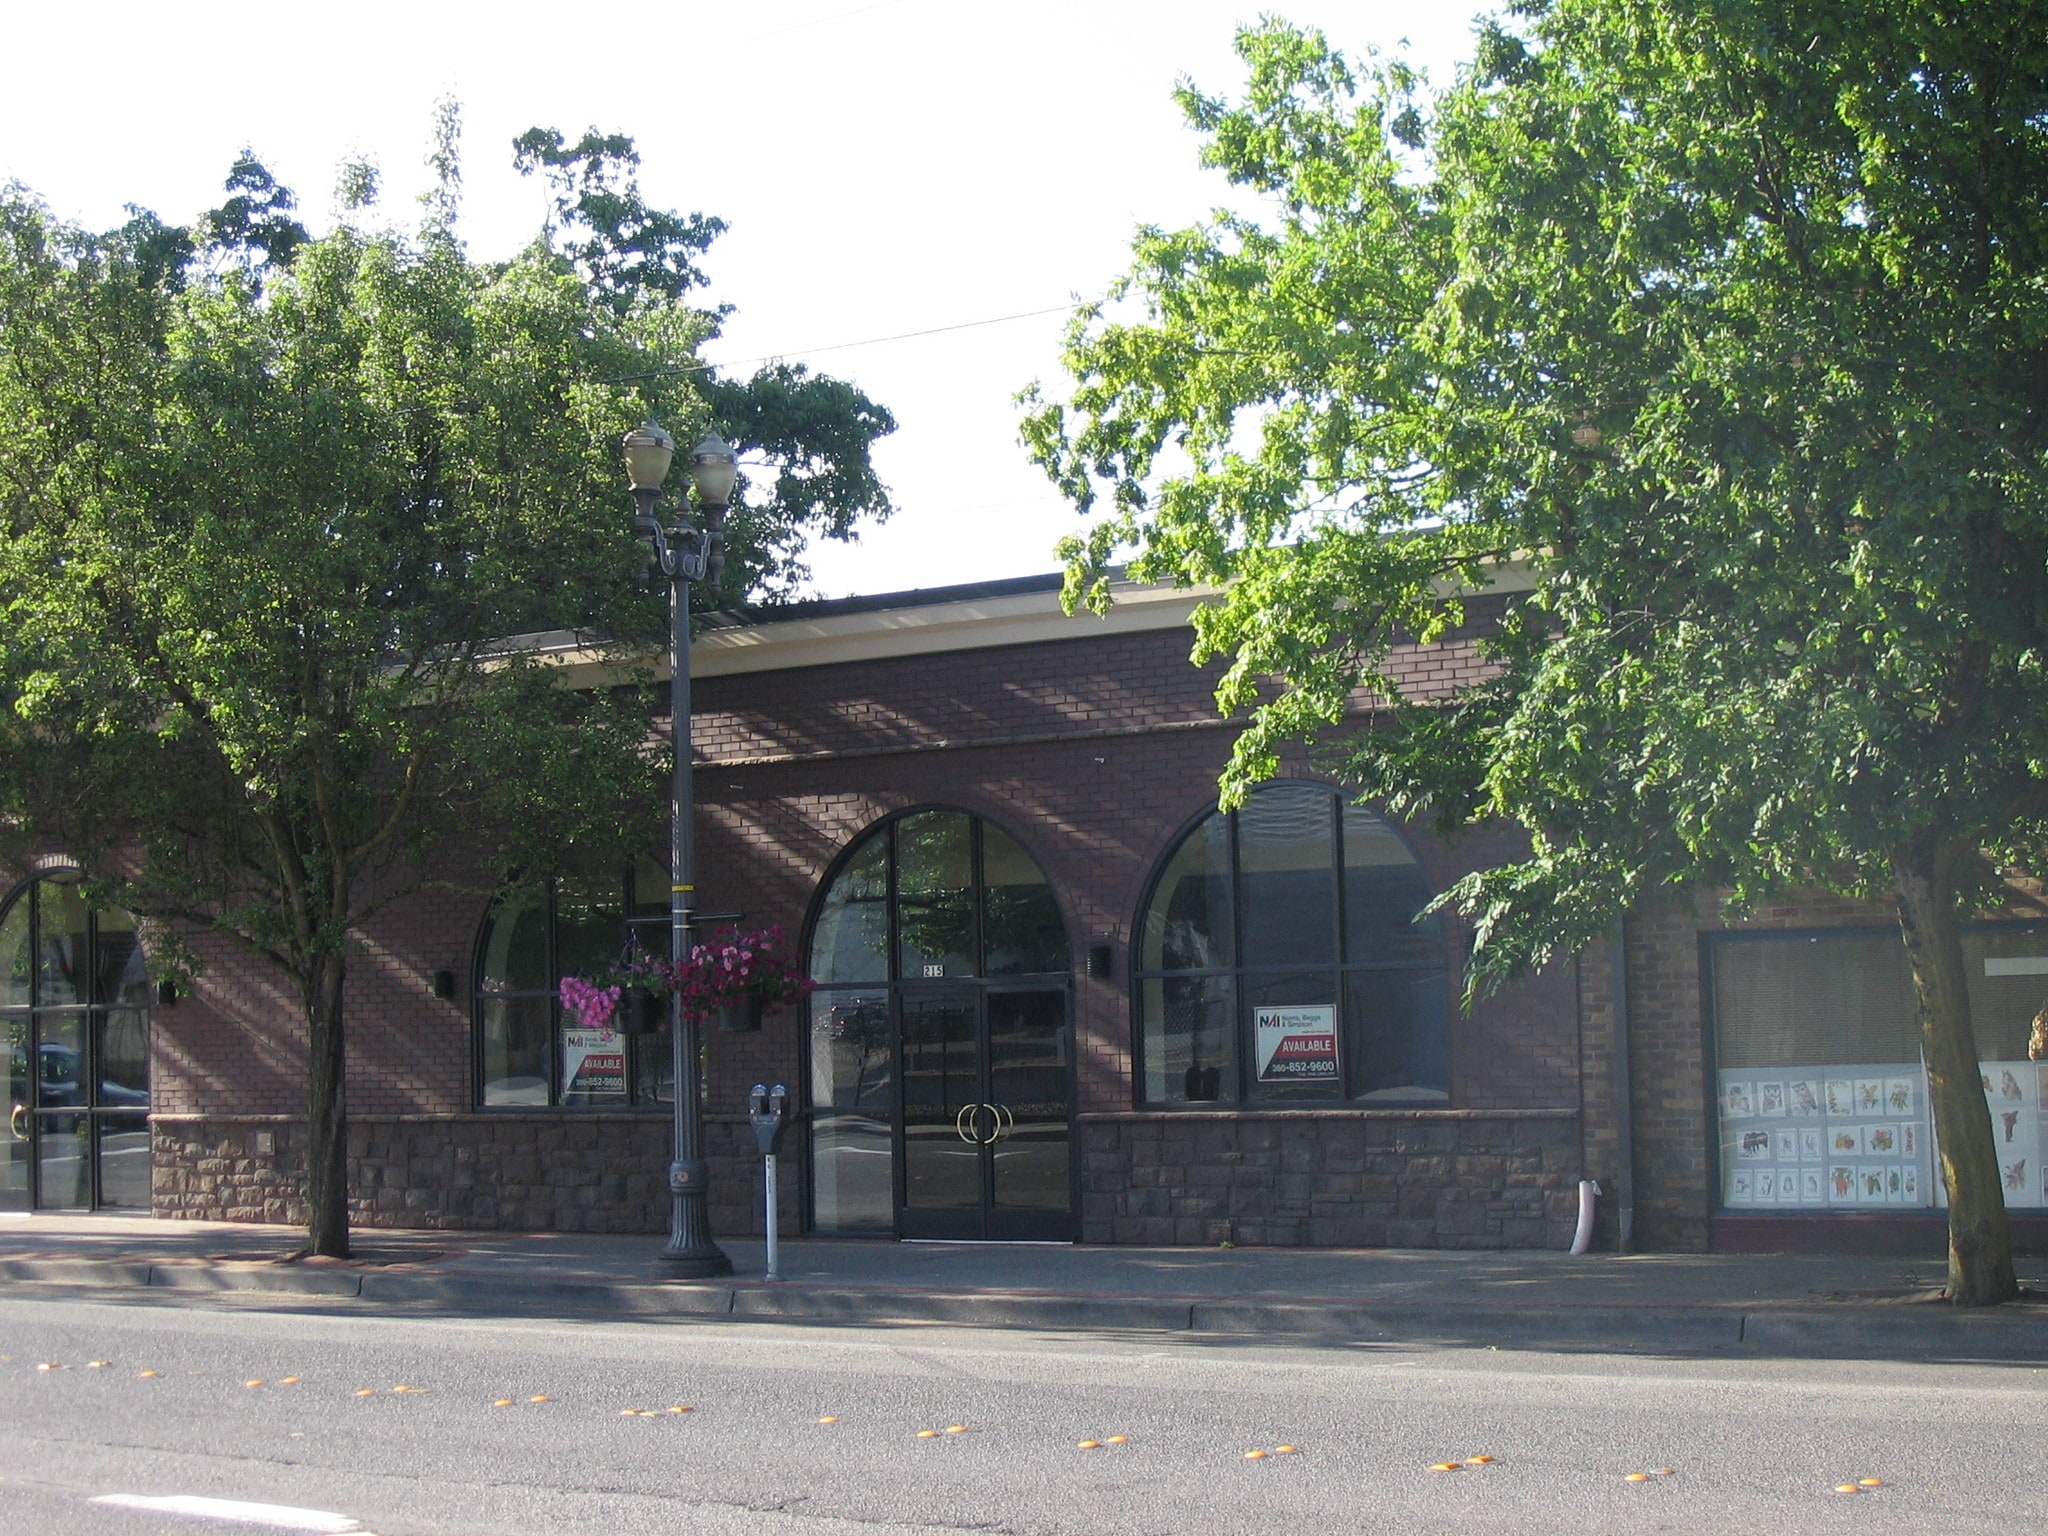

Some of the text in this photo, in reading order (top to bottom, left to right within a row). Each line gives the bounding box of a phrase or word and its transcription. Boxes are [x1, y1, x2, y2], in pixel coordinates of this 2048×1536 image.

[924, 966, 942, 976] 215
[1260, 1013, 1280, 1028] NAI
[568, 1036, 583, 1047] NAI
[1282, 1040, 1331, 1052] AVAILABLE
[584, 1059, 621, 1069] AVAILABLE
[1272, 1061, 1334, 1072] 360-852-9600
